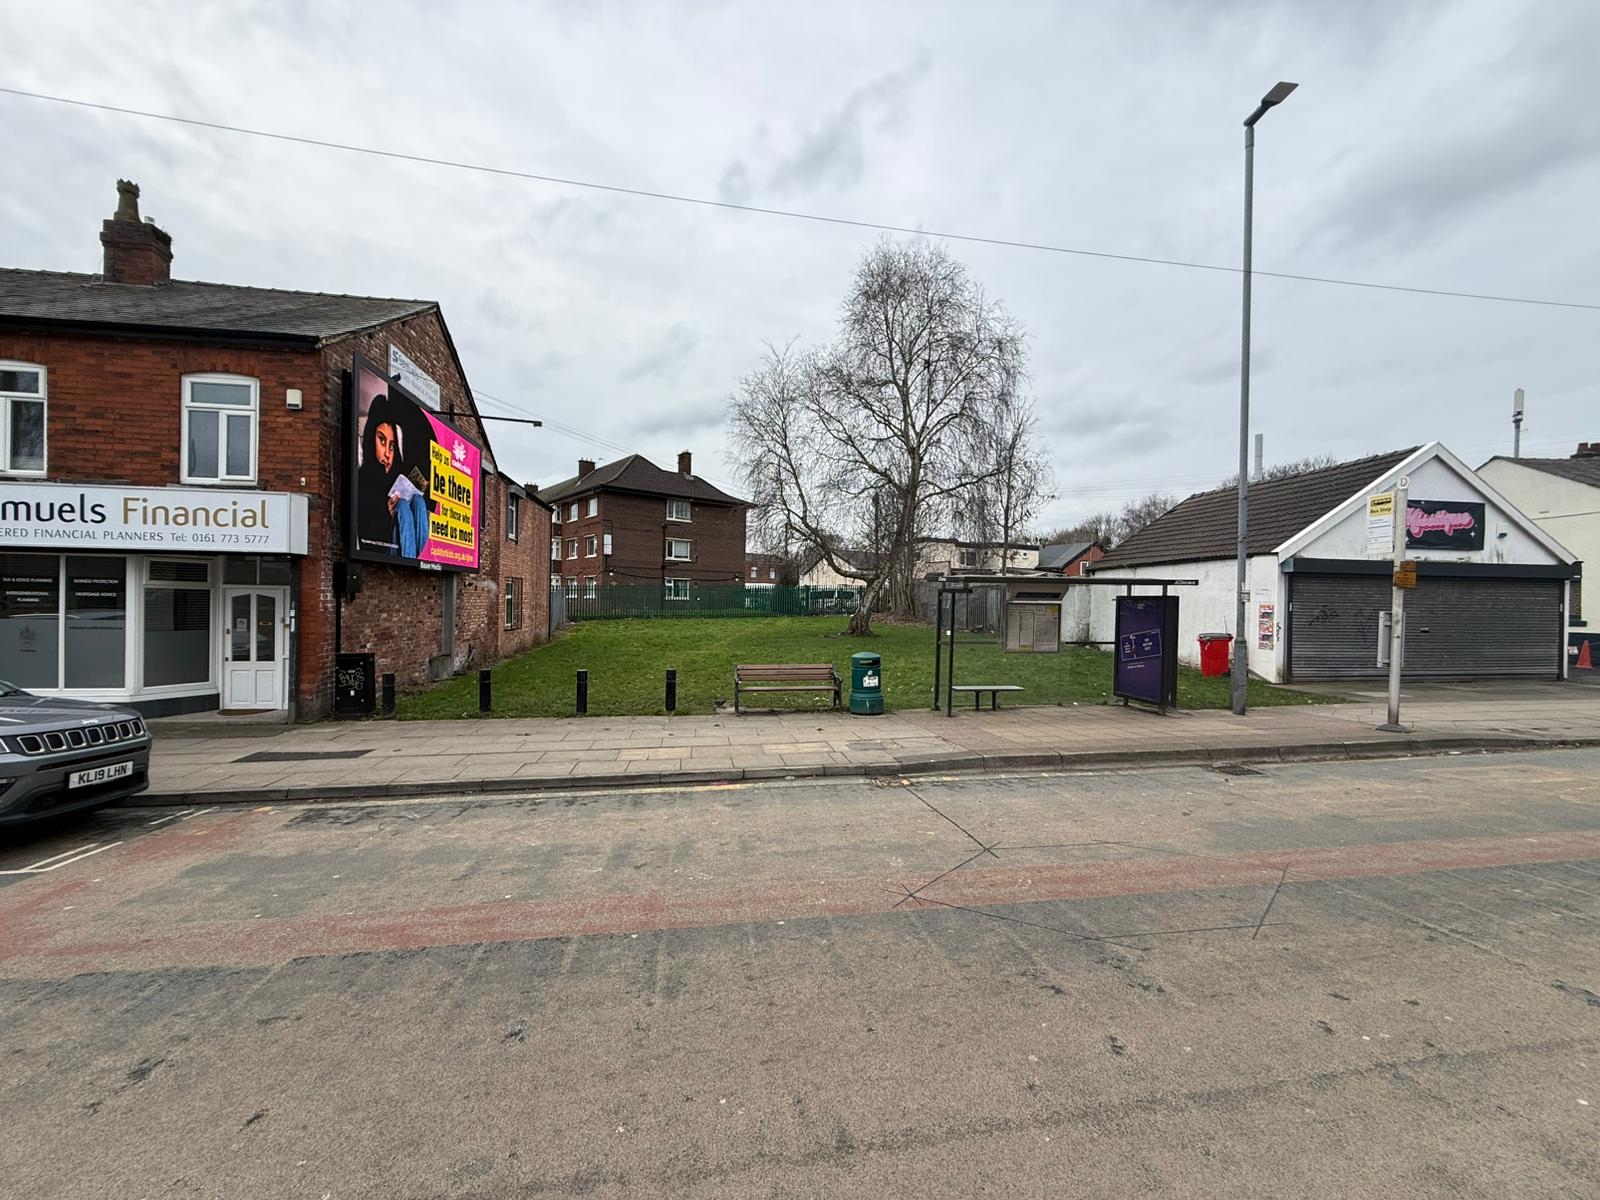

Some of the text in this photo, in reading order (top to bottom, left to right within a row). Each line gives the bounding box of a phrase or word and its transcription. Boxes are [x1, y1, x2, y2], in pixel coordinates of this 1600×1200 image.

[433, 465, 471, 506] be there
[1, 493, 269, 529] muels Financial
[441, 503, 470, 525] for those who
[34, 529, 98, 540] FINANCIAL
[103, 530, 164, 541] PLANNERS
[170, 532, 188, 542] Tel:
[192, 533, 216, 543] 0161
[220, 534, 240, 544] 773
[244, 534, 269, 544] 5777
[431, 520, 473, 544] need us most
[77, 764, 128, 786] KL19 LHN
